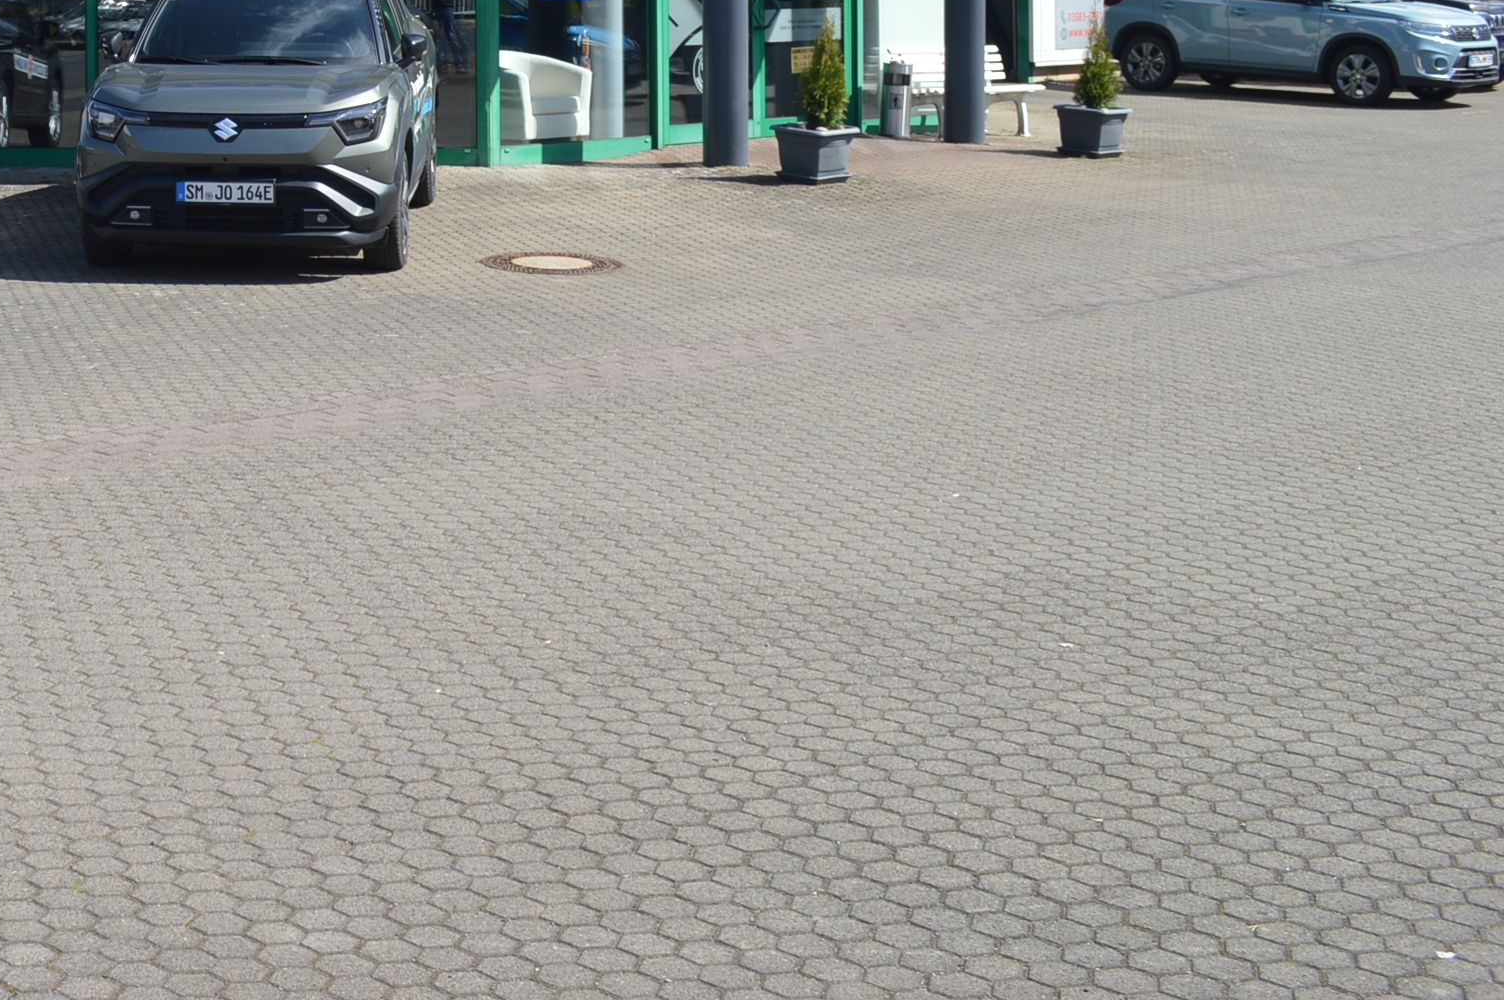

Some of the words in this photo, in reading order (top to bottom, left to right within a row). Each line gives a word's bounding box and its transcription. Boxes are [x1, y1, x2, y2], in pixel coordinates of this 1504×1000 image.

[186, 184, 204, 200] SM
[215, 185, 232, 200] JO
[237, 185, 272, 201] 164E
